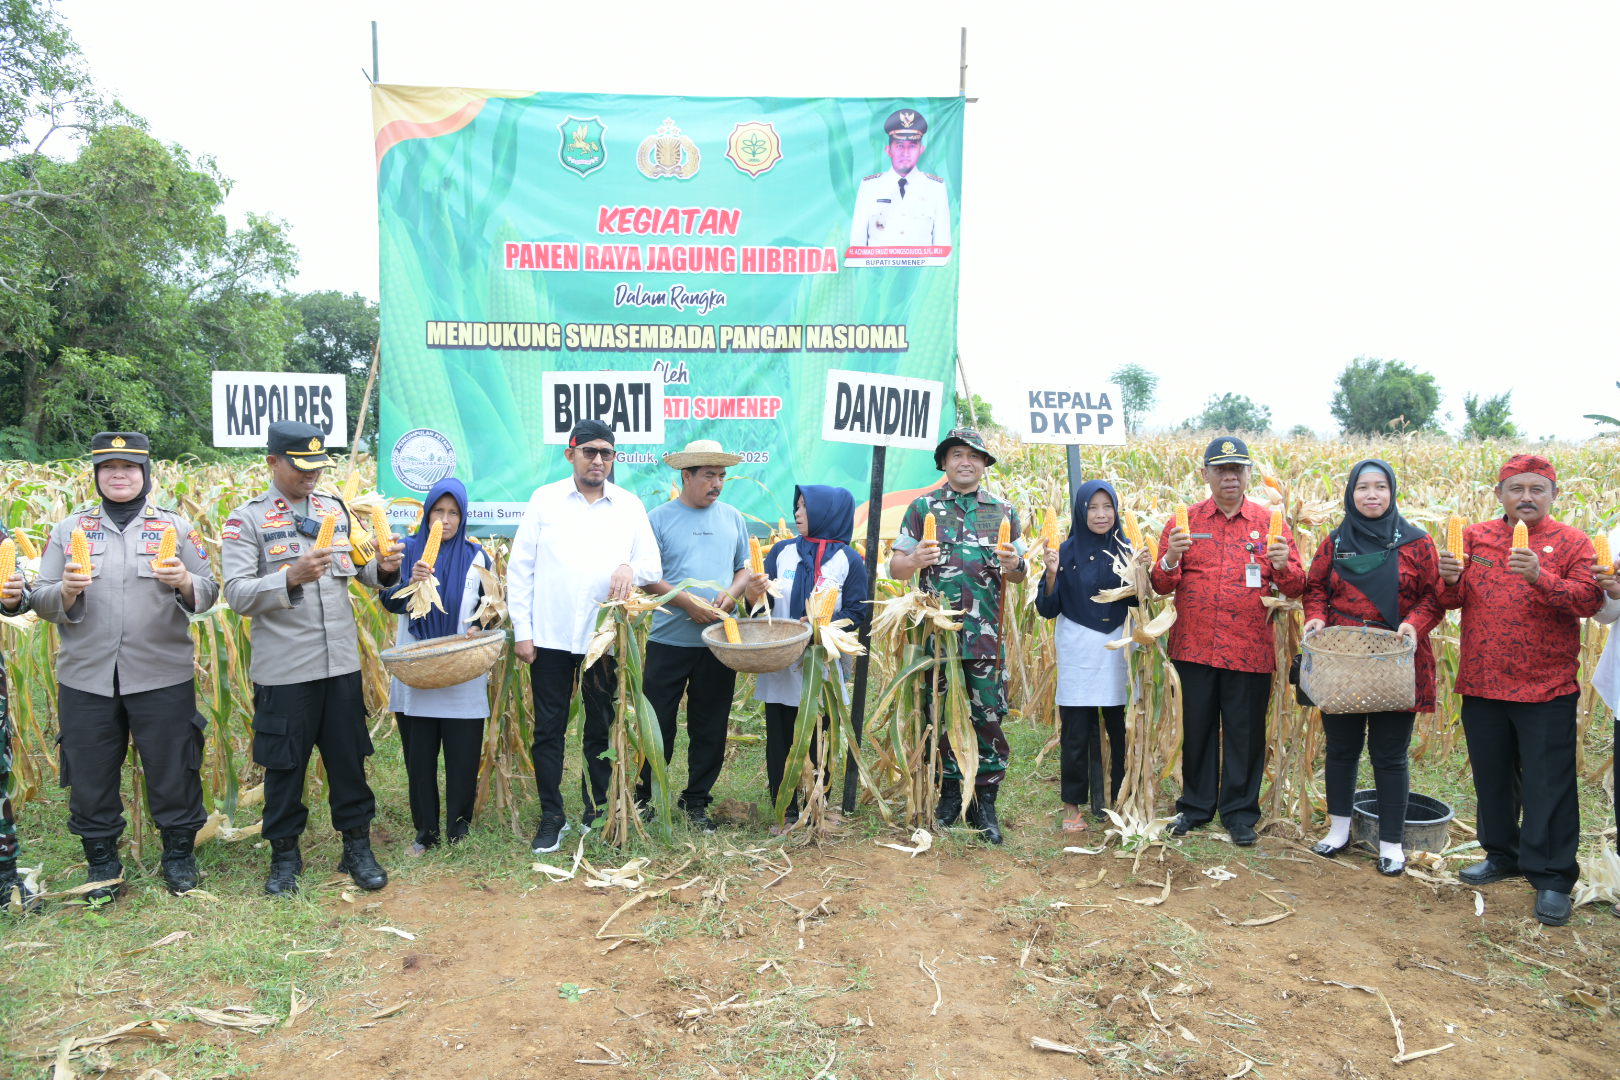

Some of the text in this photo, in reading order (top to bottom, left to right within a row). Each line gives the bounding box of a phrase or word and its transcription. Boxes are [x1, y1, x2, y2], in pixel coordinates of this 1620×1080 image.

[598, 206, 741, 235] KEGIATAN
[505, 243, 838, 273] PANEN RAYA JAGUNG HIBRIDA
[615, 284, 725, 315] Dalam Rangka
[427, 320, 909, 351] MENDUKUNG SWASEMBADA PANGAN NASIONAL
[225, 384, 334, 436] KAPOLRES
[554, 382, 652, 433] BUPATI
[694, 397, 781, 419] SUMENEP
[833, 381, 931, 439] DANDIM
[1028, 390, 1113, 411] KEPALA
[616, 452, 659, 465] Guluk,
[740, 452, 769, 463] 2025
[466, 508, 493, 518] etani
[141, 531, 162, 541] POL
